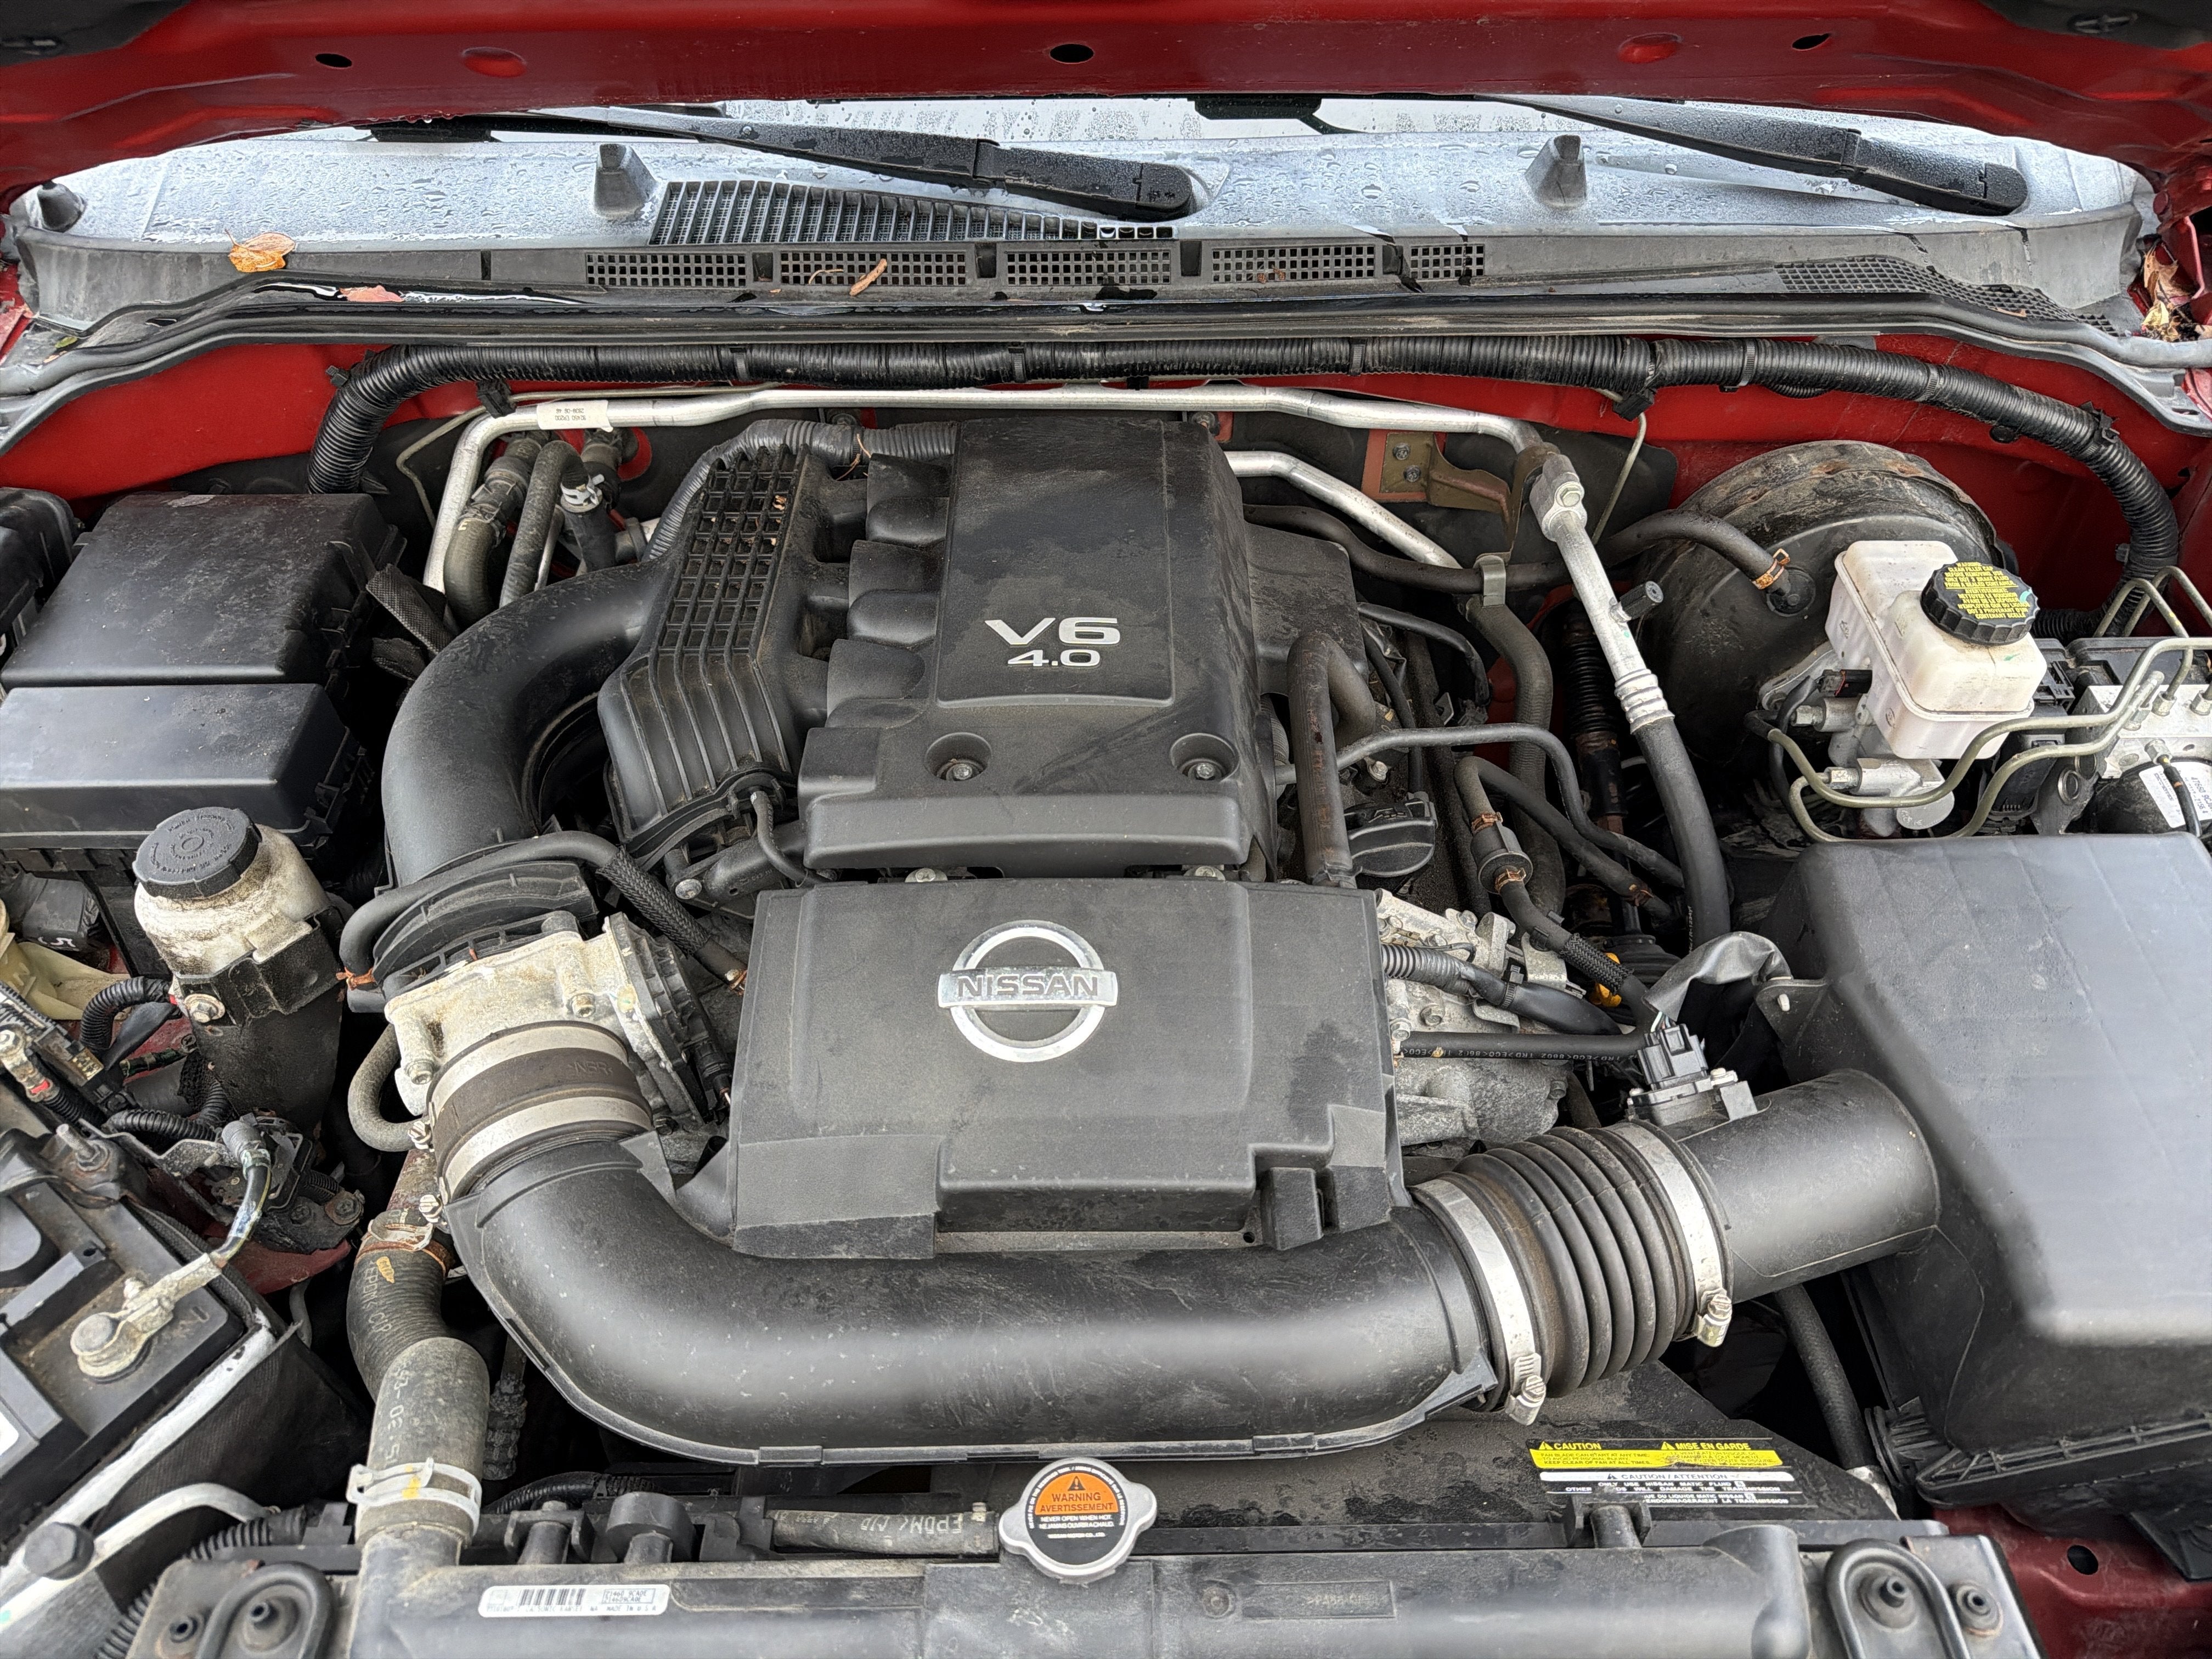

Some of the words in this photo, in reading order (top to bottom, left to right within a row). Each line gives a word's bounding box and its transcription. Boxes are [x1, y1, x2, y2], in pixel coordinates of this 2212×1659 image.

[985, 617, 1120, 645] V6
[1007, 649, 1100, 666] 4.0
[958, 974, 1098, 997] NISSAN
[1052, 1492, 1102, 1502] WARNING
[1040, 1503, 1114, 1513] AVERTISSEMENT
